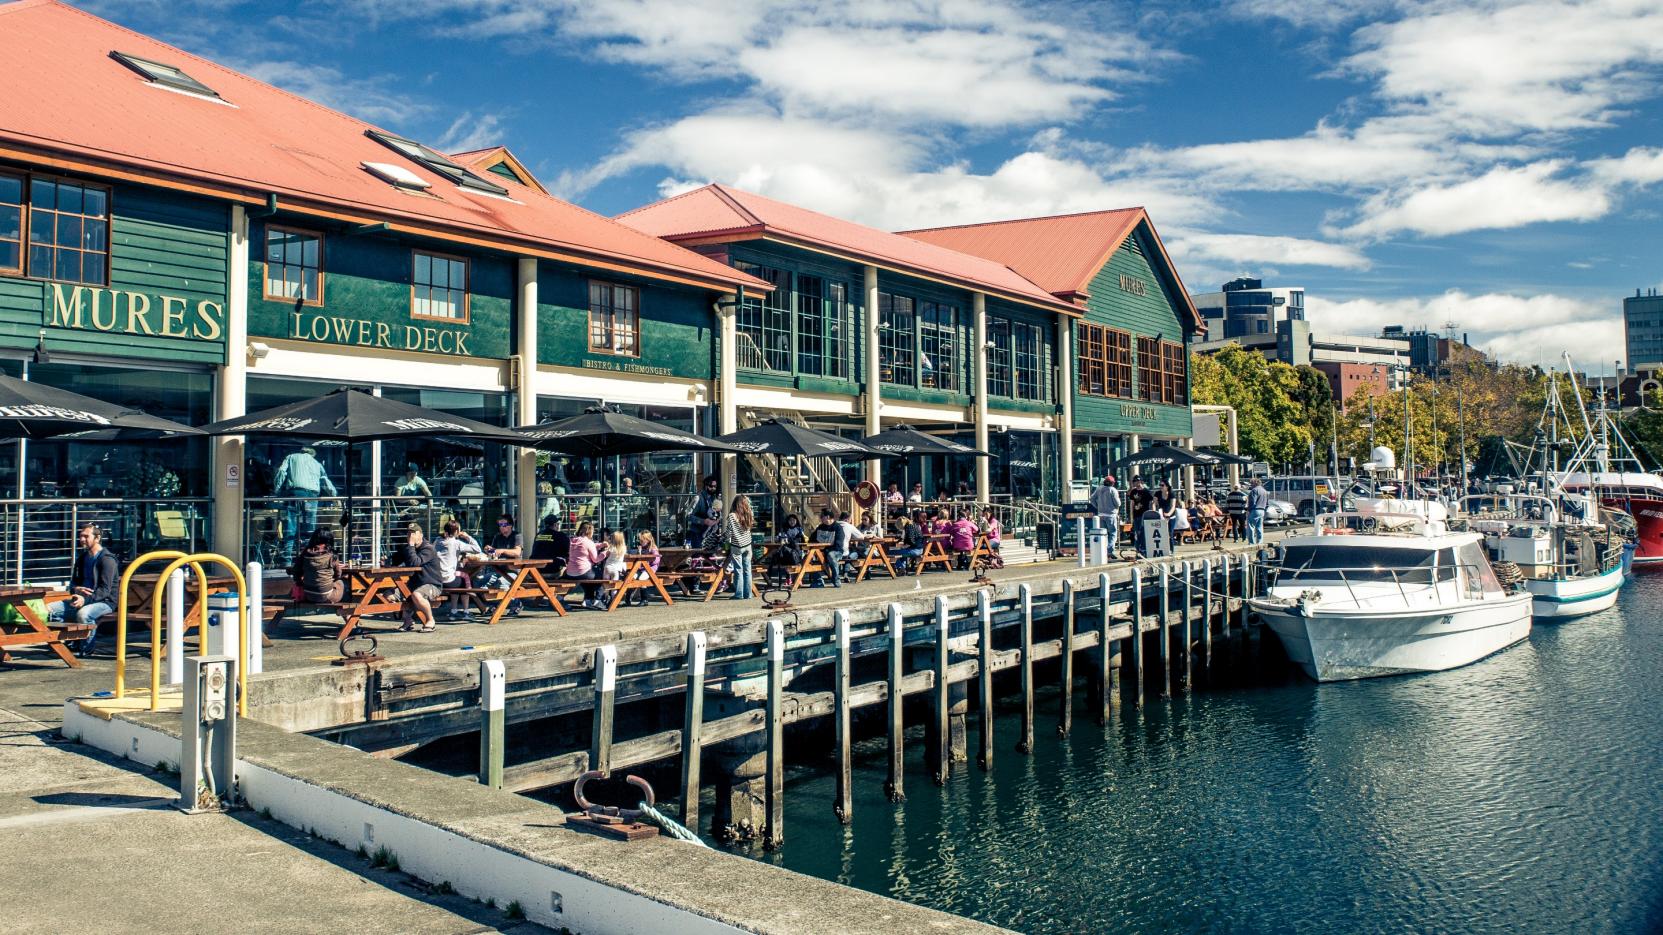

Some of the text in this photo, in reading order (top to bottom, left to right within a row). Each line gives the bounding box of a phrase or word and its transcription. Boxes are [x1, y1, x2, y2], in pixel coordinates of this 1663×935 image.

[1119, 273, 1146, 297] MURES
[50, 283, 222, 340] MURES
[292, 312, 471, 356] LOWER DECK
[586, 359, 612, 370] BISTRO
[1152, 529, 1164, 558] ATM
